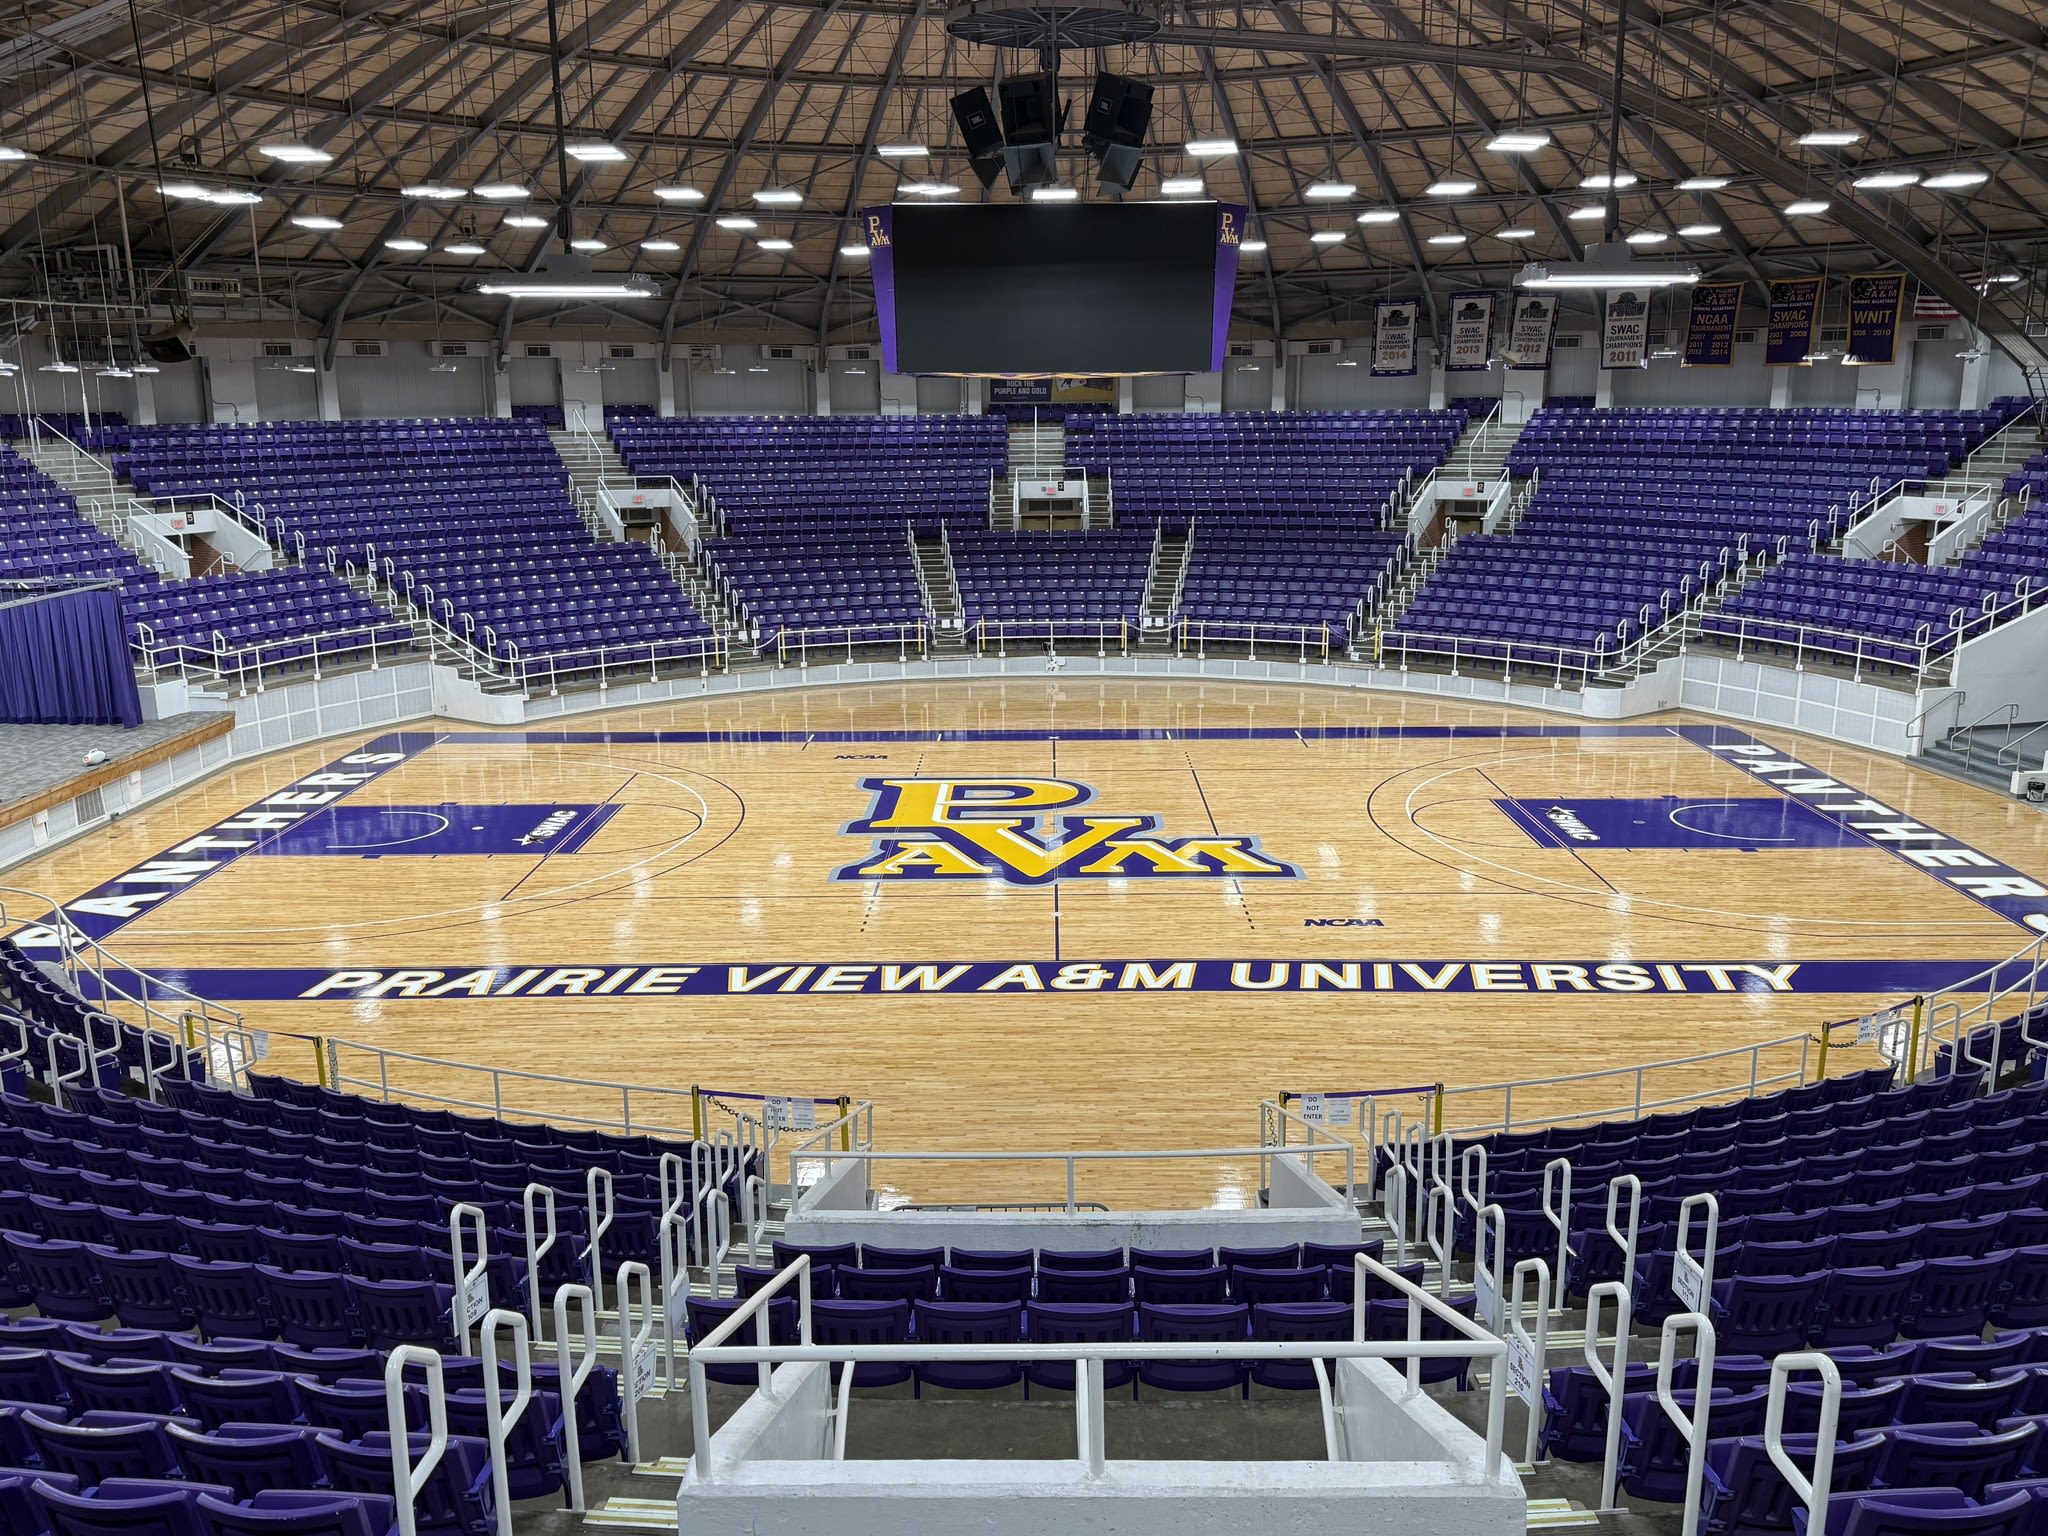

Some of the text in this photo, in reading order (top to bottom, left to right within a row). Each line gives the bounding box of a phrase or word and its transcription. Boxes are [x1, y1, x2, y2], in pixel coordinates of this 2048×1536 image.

[1696, 313, 1728, 325] NCAA
[1773, 310, 1807, 322] SWAC
[1854, 310, 1893, 324] WNIT
[1460, 326, 1480, 334] SWAC
[1521, 325, 1543, 333] SWAC
[1610, 324, 1640, 335] SWAC
[1769, 321, 1809, 329] CHAMPIONS
[1384, 332, 1406, 340] SWAC
[1606, 334, 1644, 342] TOURNAMENT
[1456, 344, 1480, 354] 2013
[1516, 343, 1541, 353] 2012
[1605, 341, 1643, 350] CHAMPIONS
[1382, 350, 1407, 360] 2014
[1609, 350, 1637, 362] 2011
[1711, 348, 1728, 356] 2014
[994, 387, 1047, 395] PURPLE AND GOLD
[530, 809, 579, 839] SWAC
[1546, 813, 1601, 841] SWAC
[11, 752, 407, 947] PANTHERS
[1303, 918, 1385, 927] NCAA
[298, 962, 1801, 997] PRAIRIE VIEW A&M UNIVERSITY
[1677, 1275, 1695, 1299] SECTION
[1510, 1362, 1531, 1390] SECTION
[1514, 1377, 1524, 1391] 210
